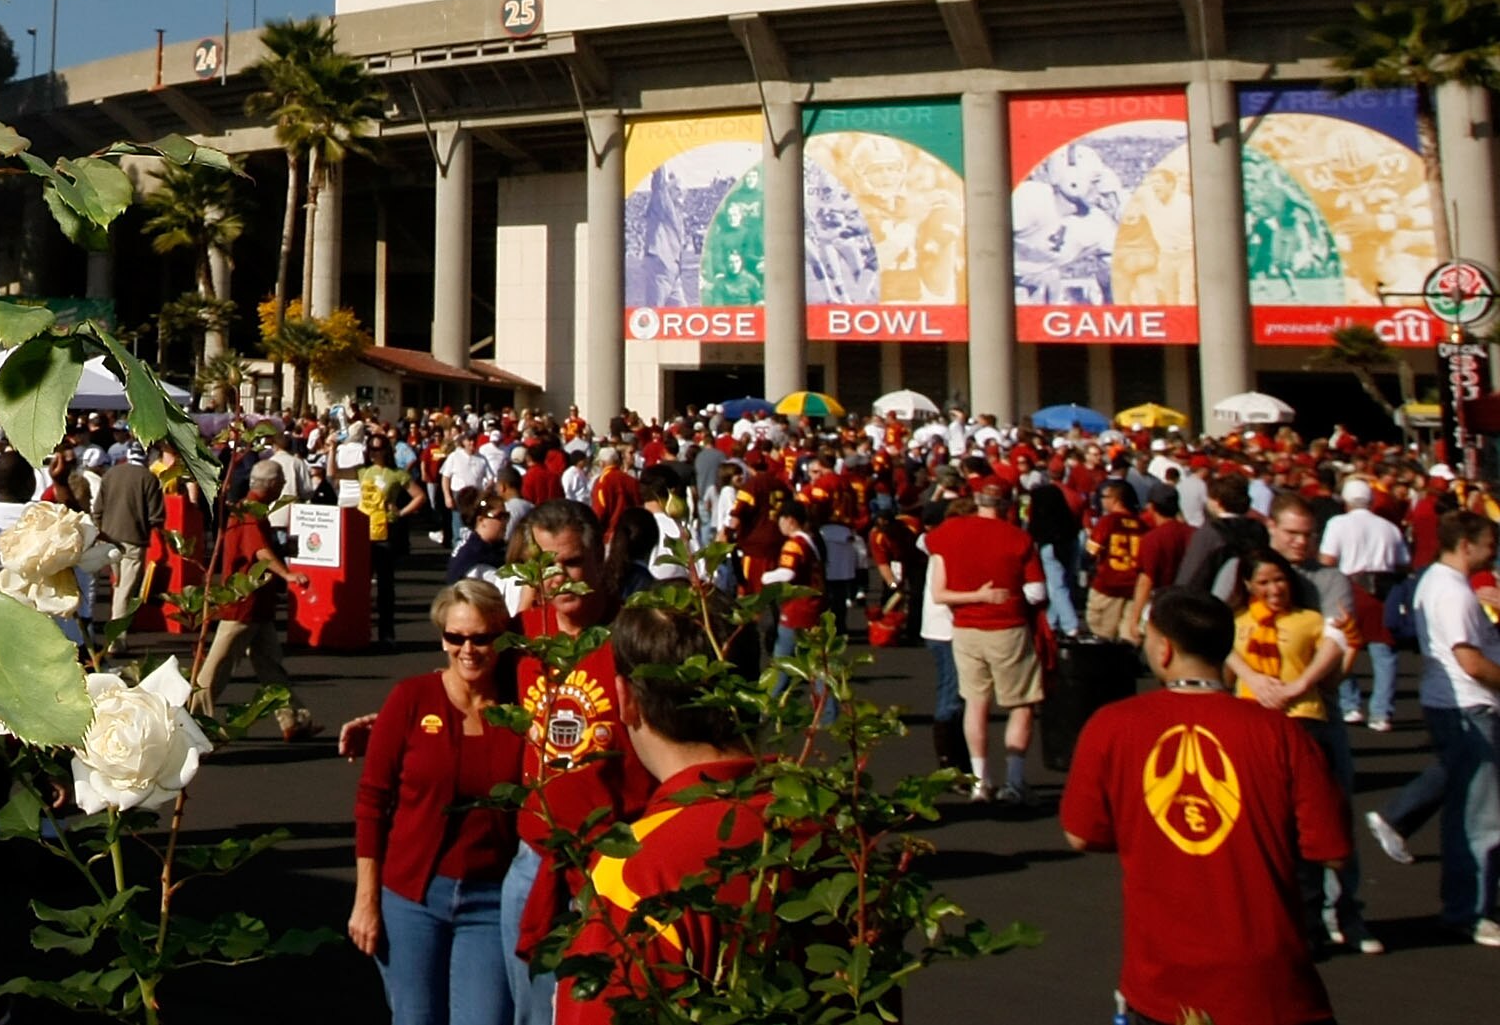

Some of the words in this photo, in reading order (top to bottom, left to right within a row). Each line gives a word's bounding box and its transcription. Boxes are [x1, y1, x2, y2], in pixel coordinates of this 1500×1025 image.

[195, 45, 217, 71] 24
[830, 107, 933, 128] HONOR
[1026, 95, 1166, 119] PASSION
[635, 119, 755, 140] TRADITION
[663, 312, 756, 337] ROSE
[827, 309, 944, 336] BOWL
[1042, 311, 1167, 338] GAME
[1373, 308, 1431, 343] citi
